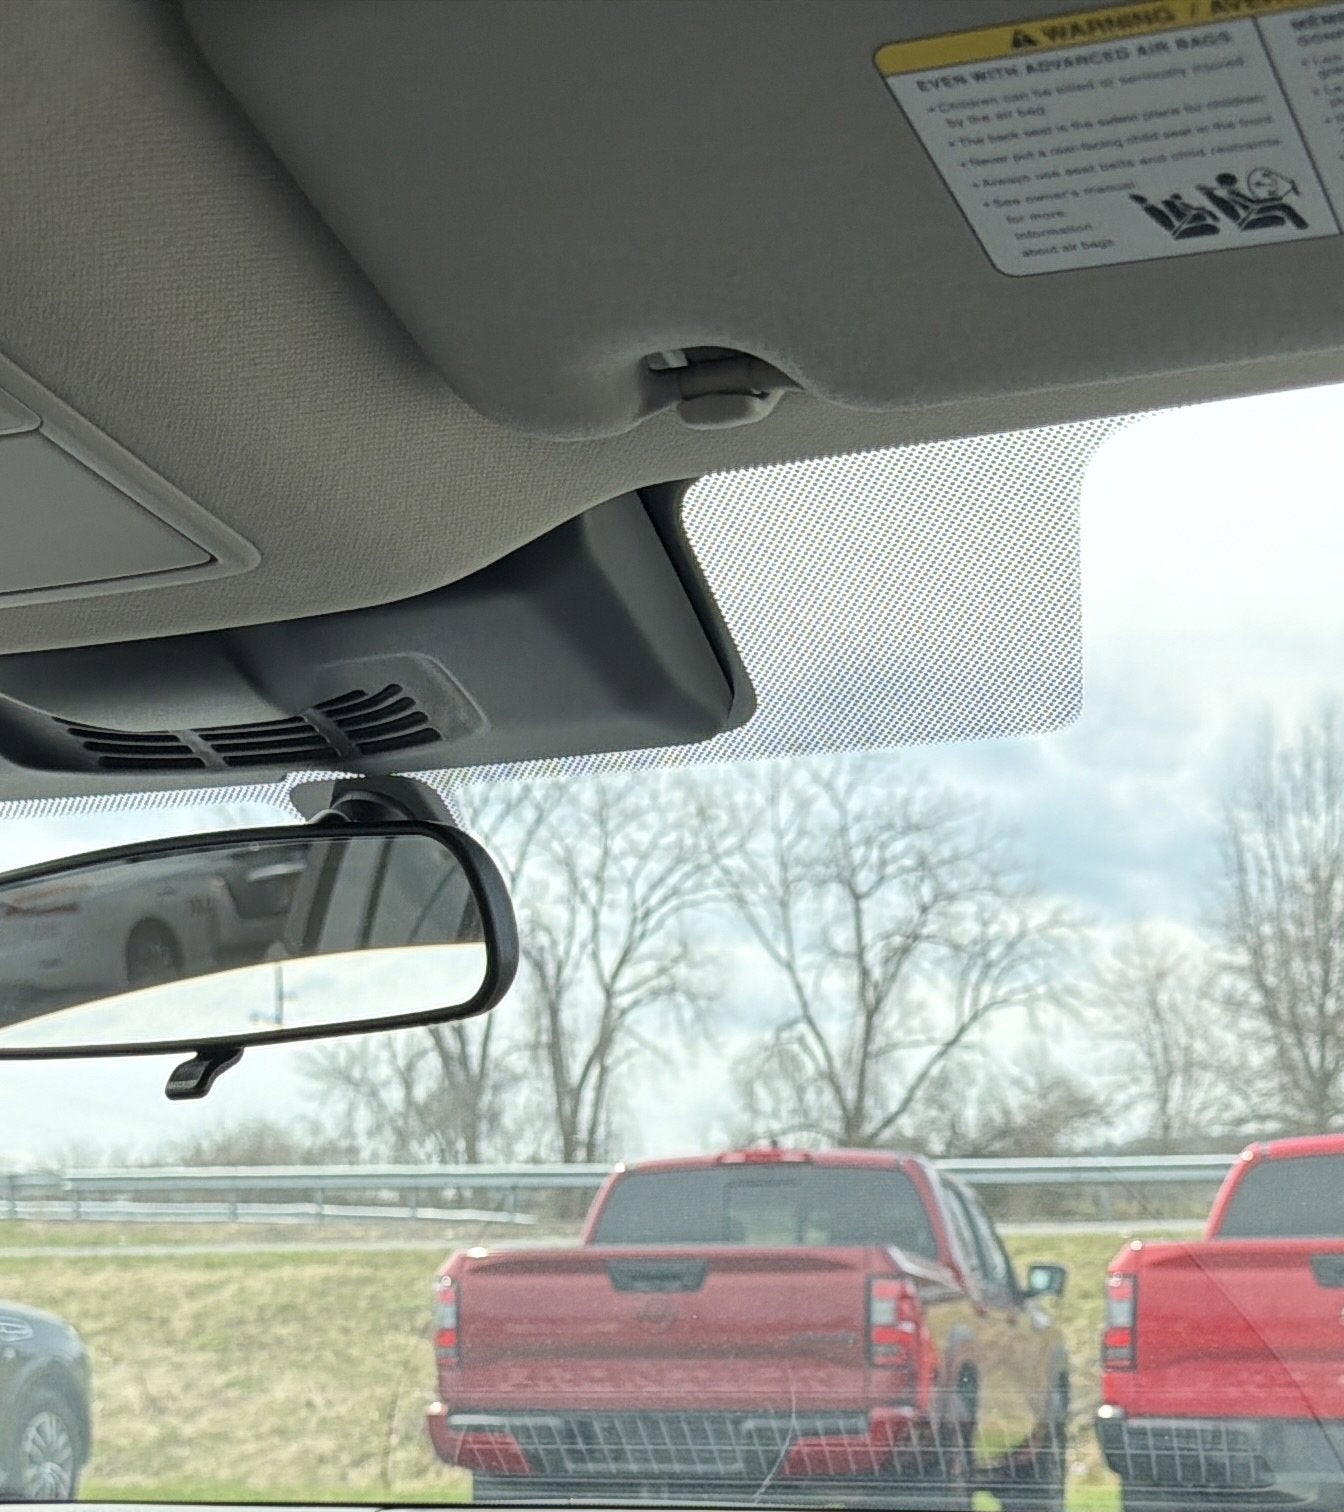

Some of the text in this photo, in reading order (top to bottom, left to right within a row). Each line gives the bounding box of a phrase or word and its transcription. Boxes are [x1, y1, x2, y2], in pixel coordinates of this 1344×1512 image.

[918, 31, 1230, 91] EVEN WITH ADVANCED AIR BAGS
